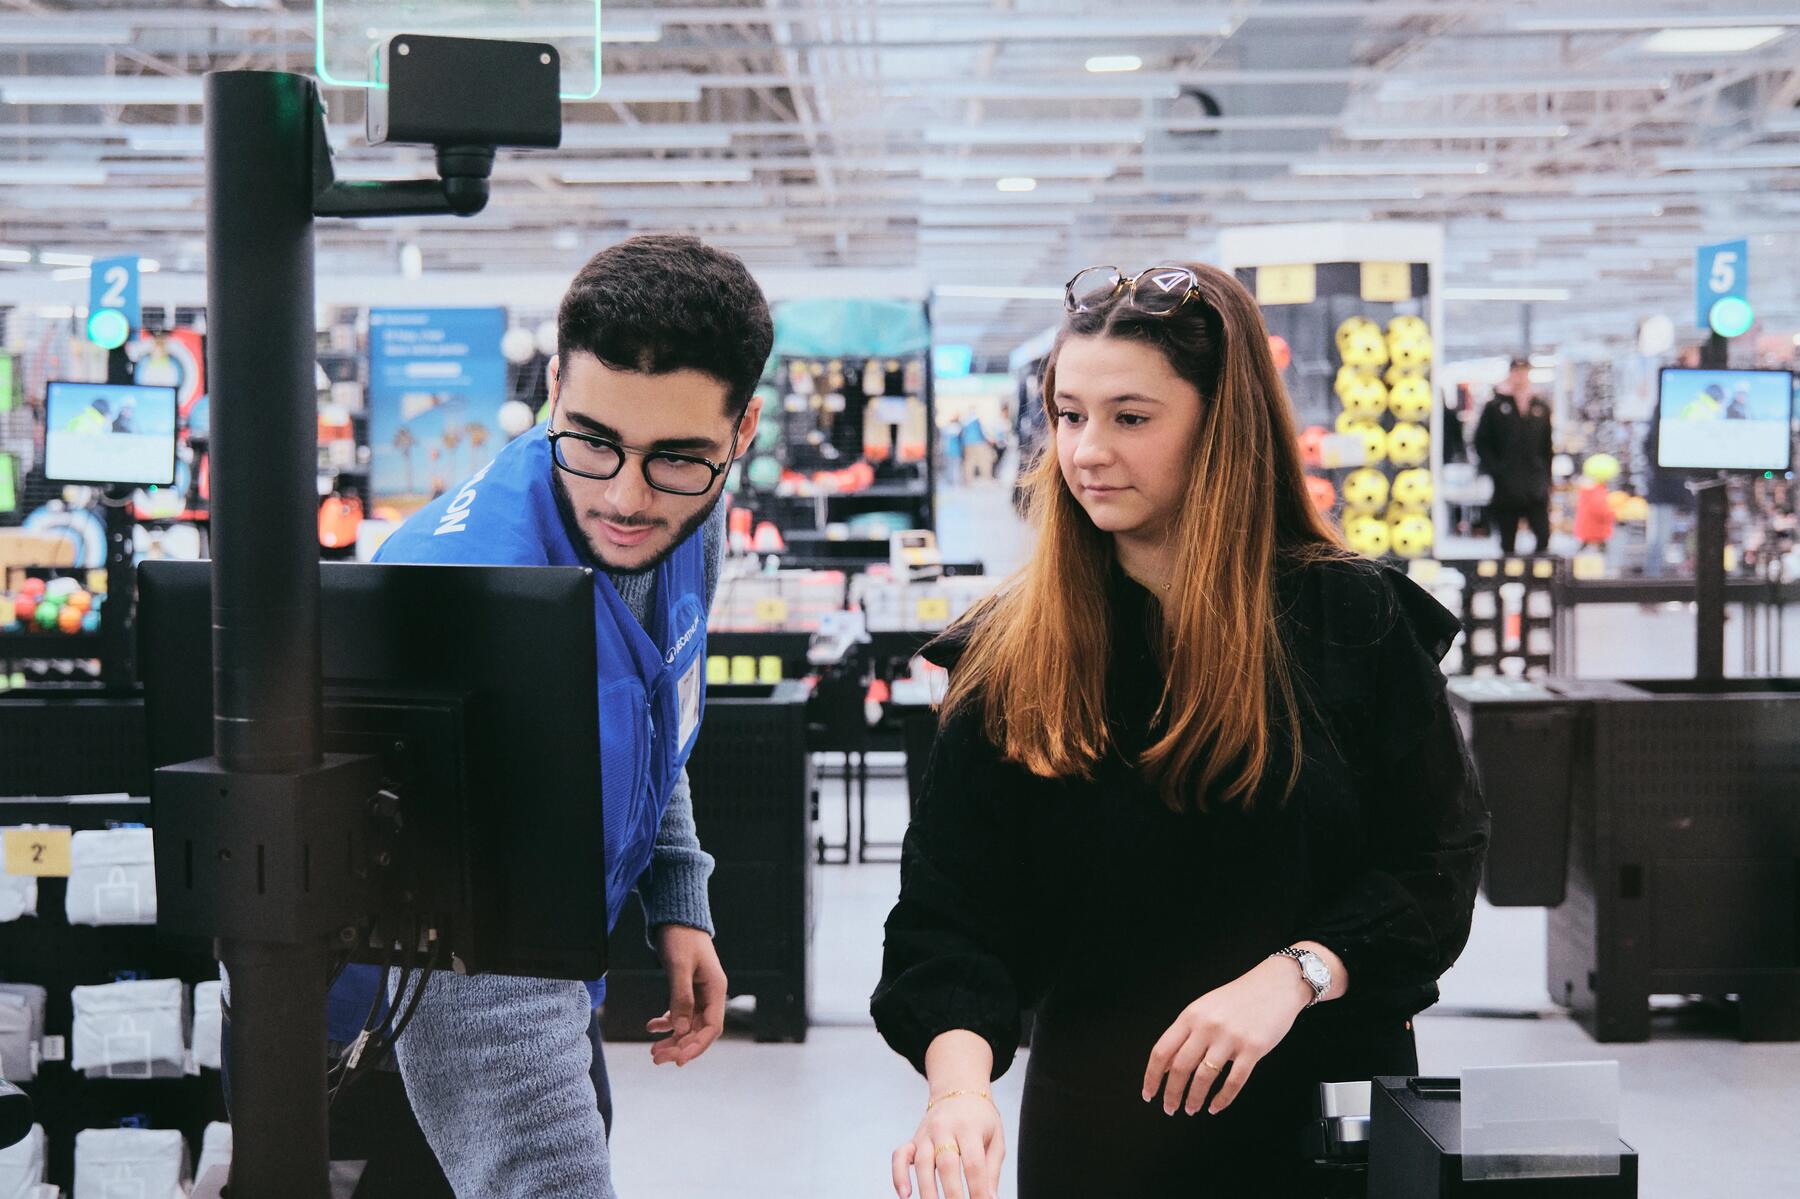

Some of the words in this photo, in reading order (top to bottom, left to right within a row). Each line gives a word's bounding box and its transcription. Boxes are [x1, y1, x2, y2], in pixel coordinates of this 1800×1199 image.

[101, 266, 129, 307] 2
[1709, 251, 1737, 293] 5
[433, 462, 492, 536] LON
